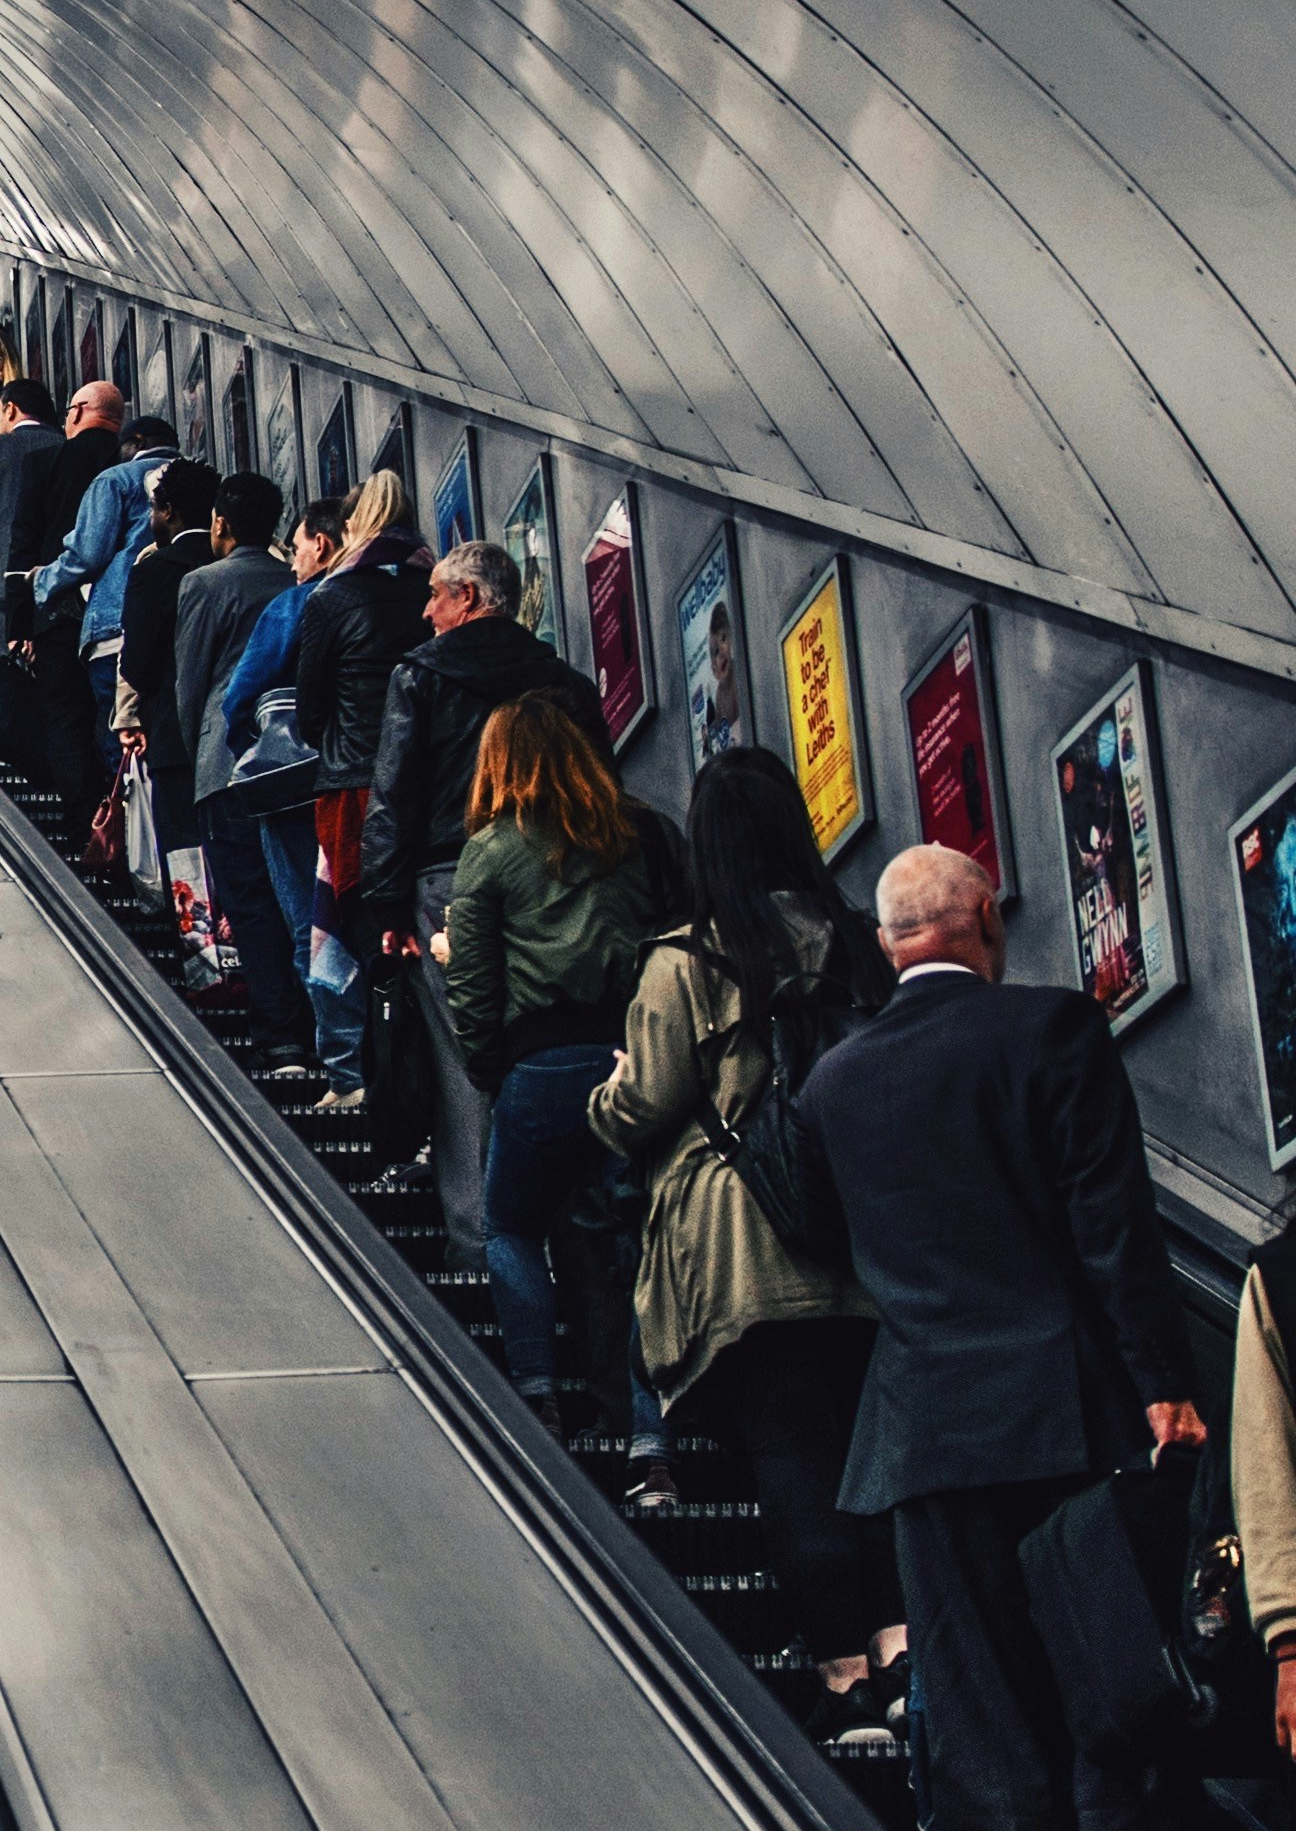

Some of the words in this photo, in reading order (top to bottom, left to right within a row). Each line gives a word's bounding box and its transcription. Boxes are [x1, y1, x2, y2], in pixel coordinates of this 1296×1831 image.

[799, 618, 823, 656] Train
[801, 661, 811, 684] to
[812, 644, 825, 671] be
[801, 694, 809, 714] a
[809, 657, 831, 704] chef
[808, 696, 829, 733] with
[1077, 878, 1113, 936] NELL
[1082, 902, 1129, 976] GWYNN
